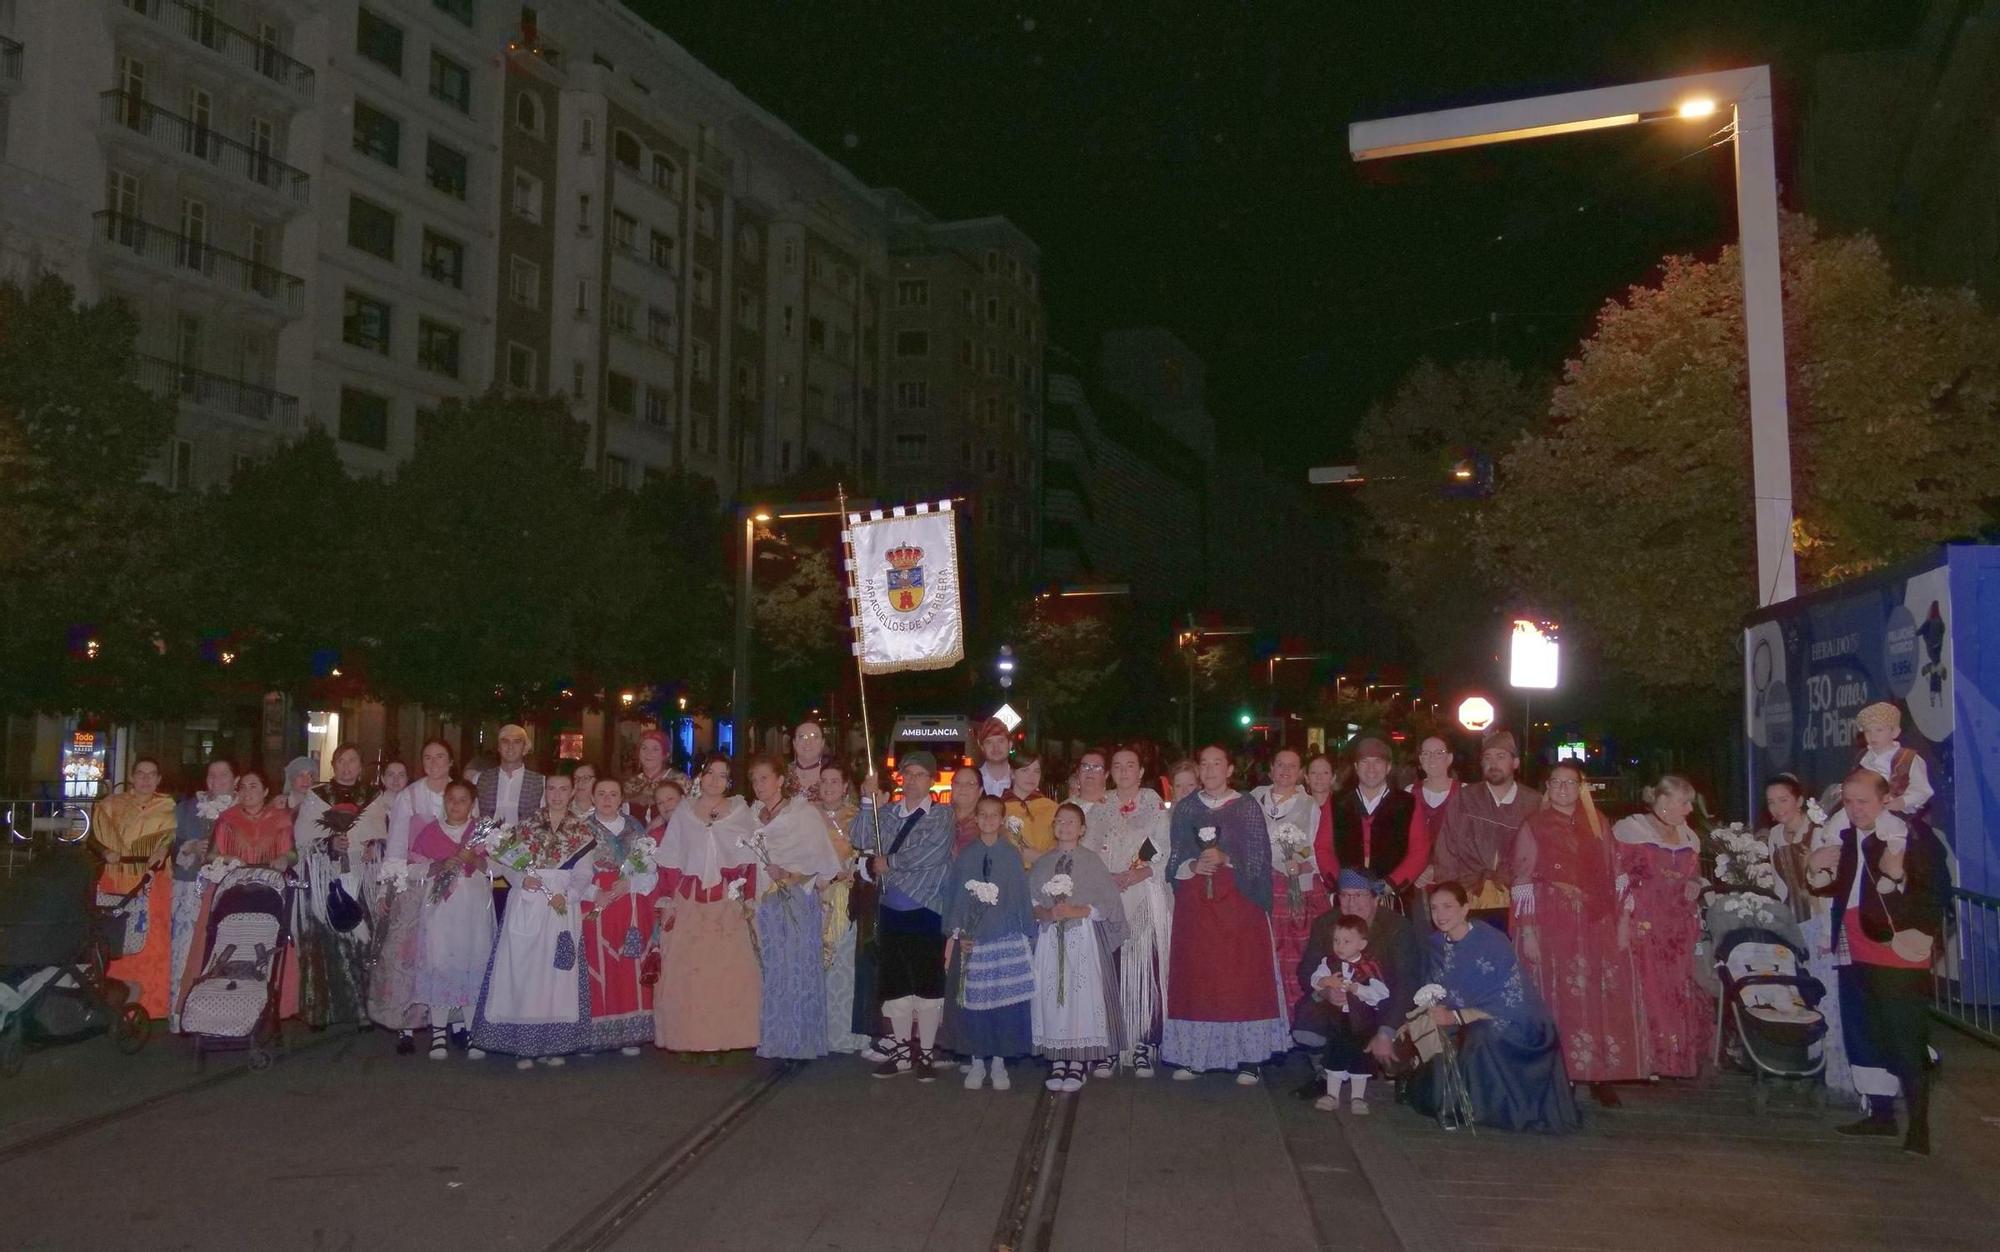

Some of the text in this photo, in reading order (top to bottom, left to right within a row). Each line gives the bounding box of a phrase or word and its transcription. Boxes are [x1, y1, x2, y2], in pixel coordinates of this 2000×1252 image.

[865, 568, 949, 632] PARACUELLOS DE LA RIBERA
[1806, 674, 1831, 712] 130
[75, 732, 94, 741] Todo
[902, 728, 959, 736] AMBULANCIA
[1802, 710, 1857, 750] de Pilar
